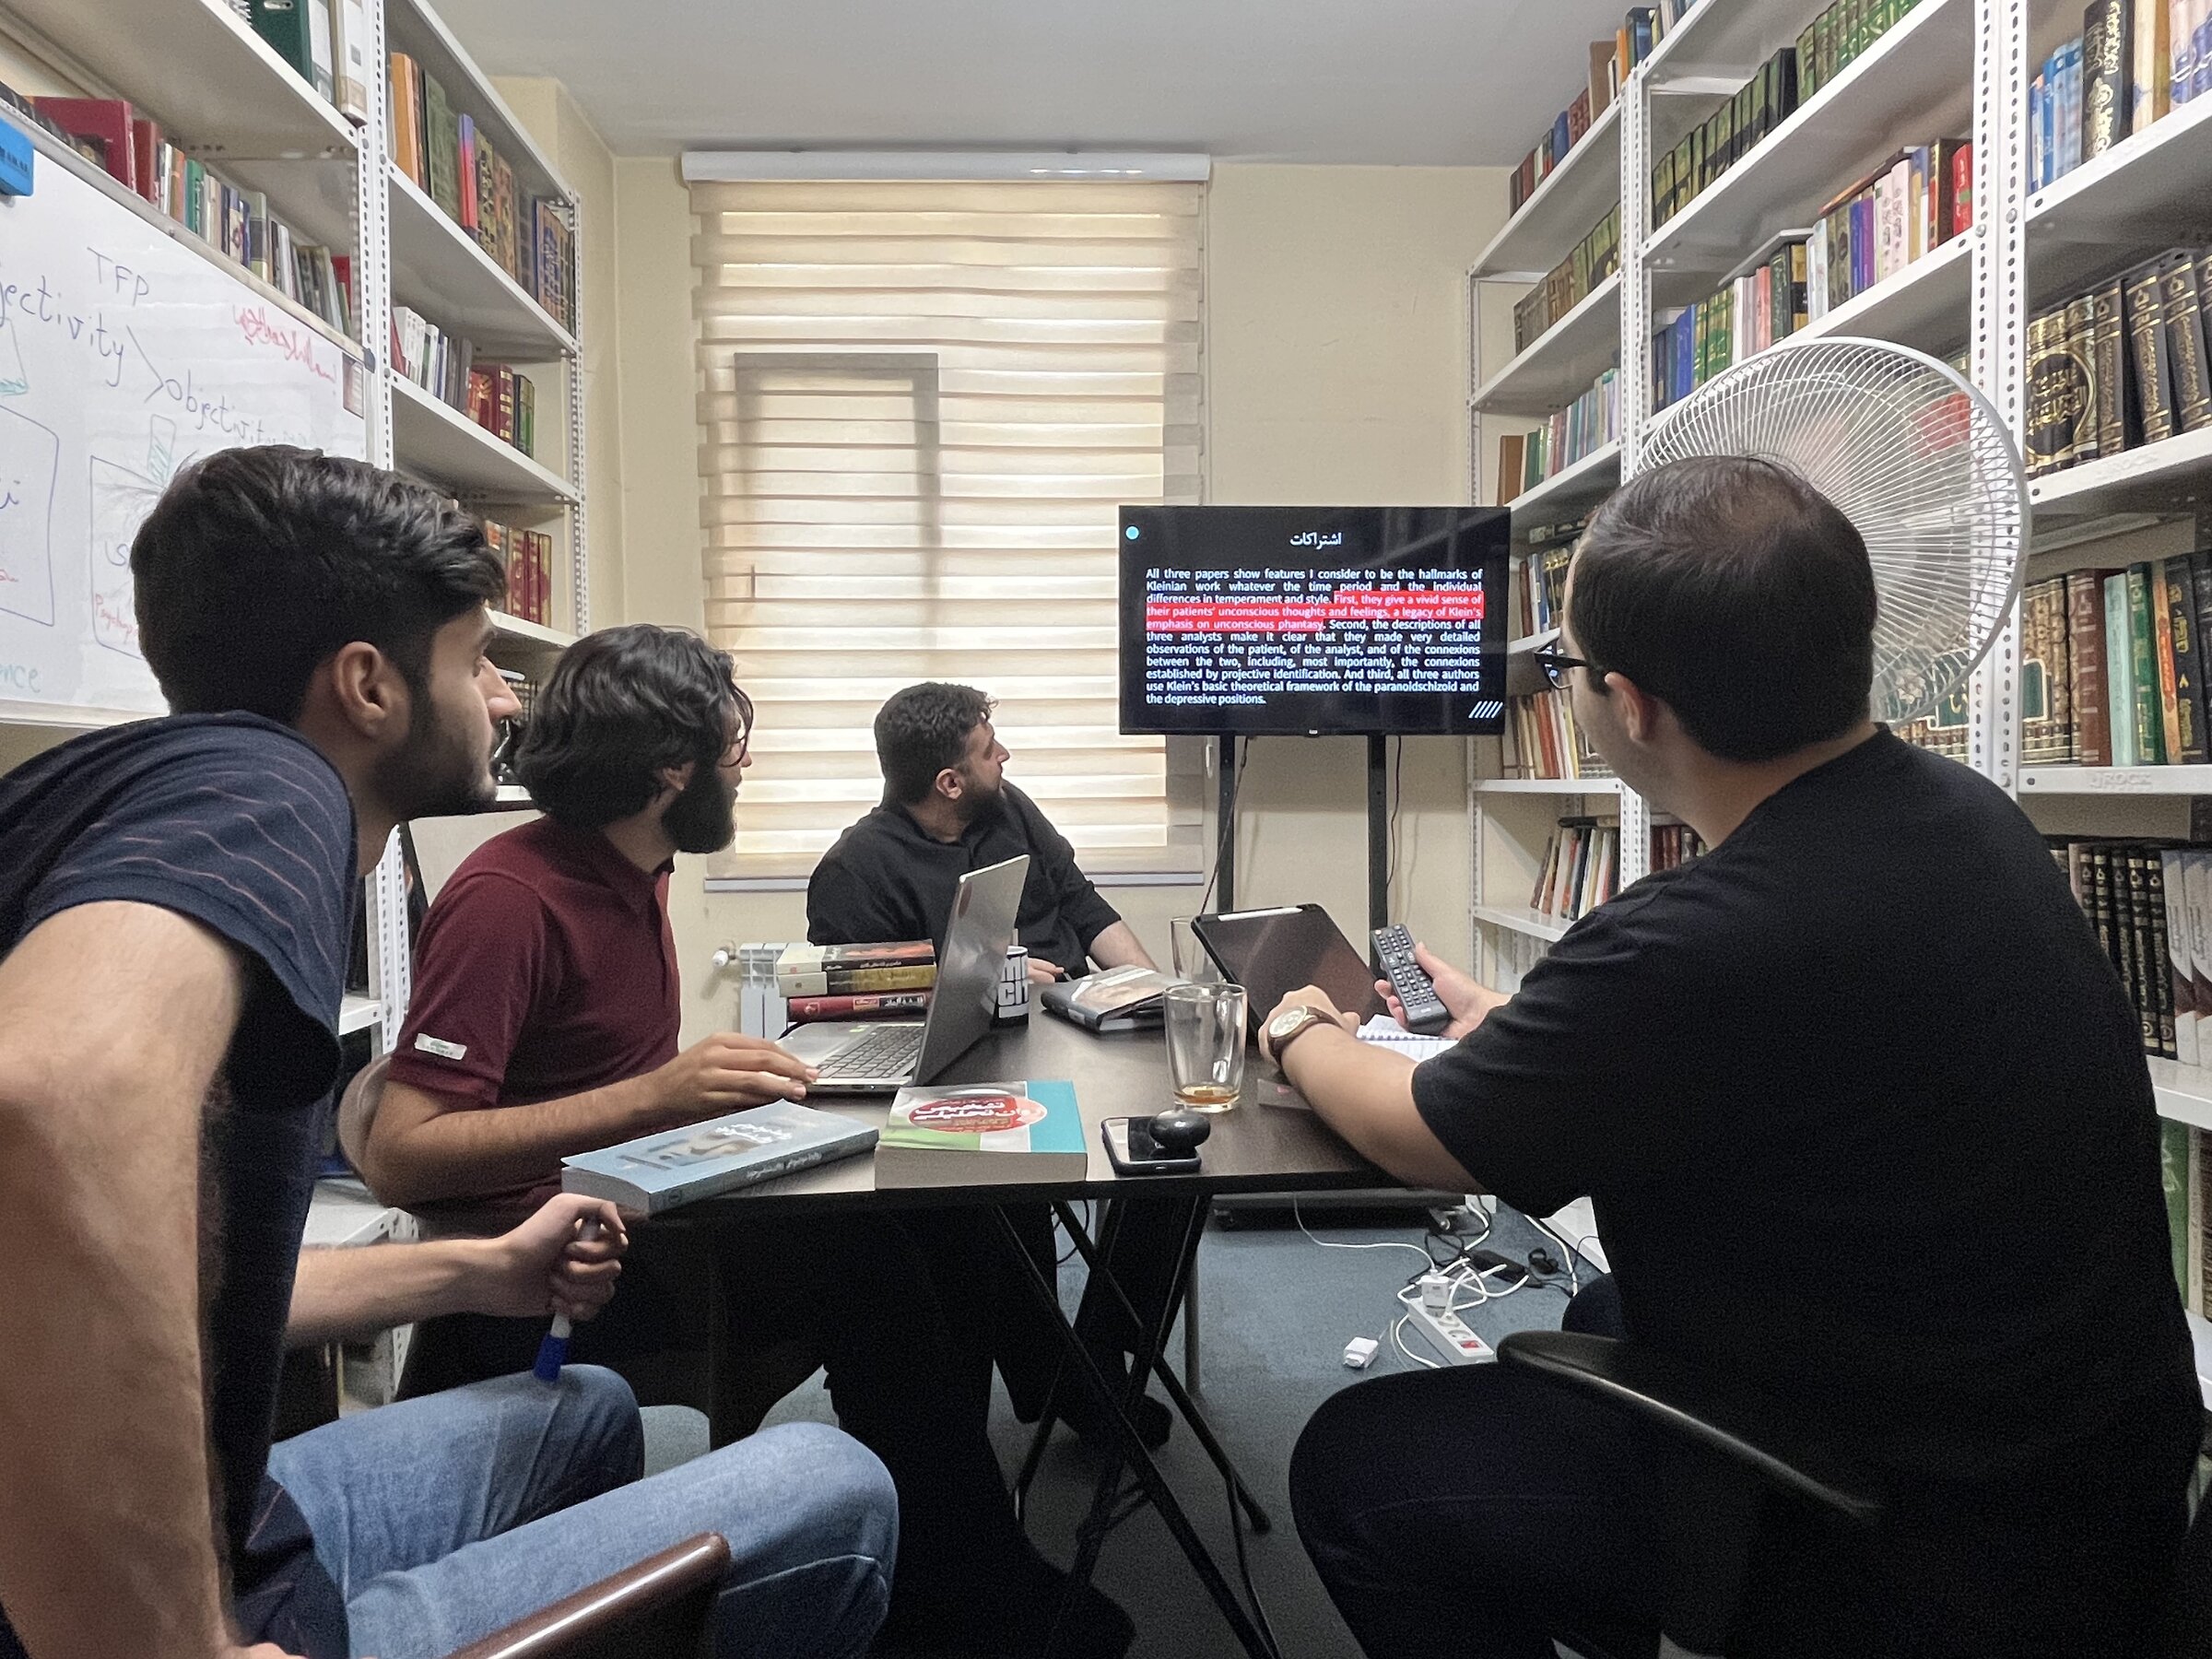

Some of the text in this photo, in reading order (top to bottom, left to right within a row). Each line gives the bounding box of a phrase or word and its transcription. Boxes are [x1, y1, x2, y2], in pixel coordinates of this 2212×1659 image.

[1146, 568, 1159, 579] All
[1164, 568, 1191, 579] three
[1195, 571, 1230, 582] papers
[1233, 568, 1261, 579] show
[1265, 568, 1305, 579] features
[1318, 568, 1360, 579] consider
[1365, 569, 1376, 579] to
[1380, 568, 1394, 579] be
[1397, 568, 1415, 579] the
[1418, 568, 1467, 579] hallmarks
[1471, 568, 1483, 579] of
[1147, 581, 1482, 594] Kleinian work whatever the time period and the individual
[1147, 593, 1201, 604] differences
[1203, 593, 1212, 604] in
[1215, 594, 1282, 606] temperament
[1284, 593, 1303, 604] and
[1361, 593, 1382, 606] they
[1385, 593, 1406, 606] give
[1416, 593, 1440, 604] vivid
[1441, 595, 1469, 604] sense
[1471, 593, 1484, 604] of
[1147, 606, 1171, 617] their
[1218, 606, 1280, 617] unconscious
[1282, 606, 1326, 619] thoughts
[1328, 606, 1347, 617] and
[1402, 606, 1433, 619] legacy
[1435, 606, 1446, 617] of
[1147, 618, 1194, 632] emphasis
[1196, 621, 1210, 629] on
[1214, 618, 1275, 629] unconscious
[1371, 618, 1389, 629] the
[1392, 618, 1452, 632] descriptions
[1454, 618, 1465, 629] of
[1468, 618, 1481, 629] all
[1147, 630, 1480, 644] three analysts make it clear that they made very detailed
[1147, 643, 1210, 653] observations
[1213, 643, 1224, 653] of
[1228, 643, 1244, 653] the
[1289, 643, 1301, 653] of
[1304, 643, 1322, 653] the
[1367, 643, 1386, 653] and
[1390, 643, 1401, 653] of
[1404, 643, 1421, 653] the
[1424, 643, 1480, 653] connexions
[1147, 655, 1189, 666] between
[1195, 655, 1213, 666] the
[1302, 656, 1328, 666] most
[1401, 655, 1418, 666] the
[1424, 655, 1480, 666] connexions
[1146, 668, 1203, 678] established
[1206, 668, 1218, 681] by
[1221, 668, 1270, 681] projective
[1344, 668, 1364, 678] And
[1397, 668, 1409, 678] all
[1412, 668, 1439, 678] three
[1441, 668, 1479, 678] authors
[1146, 683, 1164, 691] use
[1202, 680, 1229, 691] basic
[1230, 680, 1284, 691] theoretical
[1286, 680, 1340, 691] framework
[1341, 680, 1353, 691] of
[1355, 680, 1372, 691] the
[1374, 680, 1458, 694] paranoidschizoid
[1460, 680, 1479, 691] and
[1147, 693, 1163, 703] the
[1164, 693, 1217, 706] depressive
